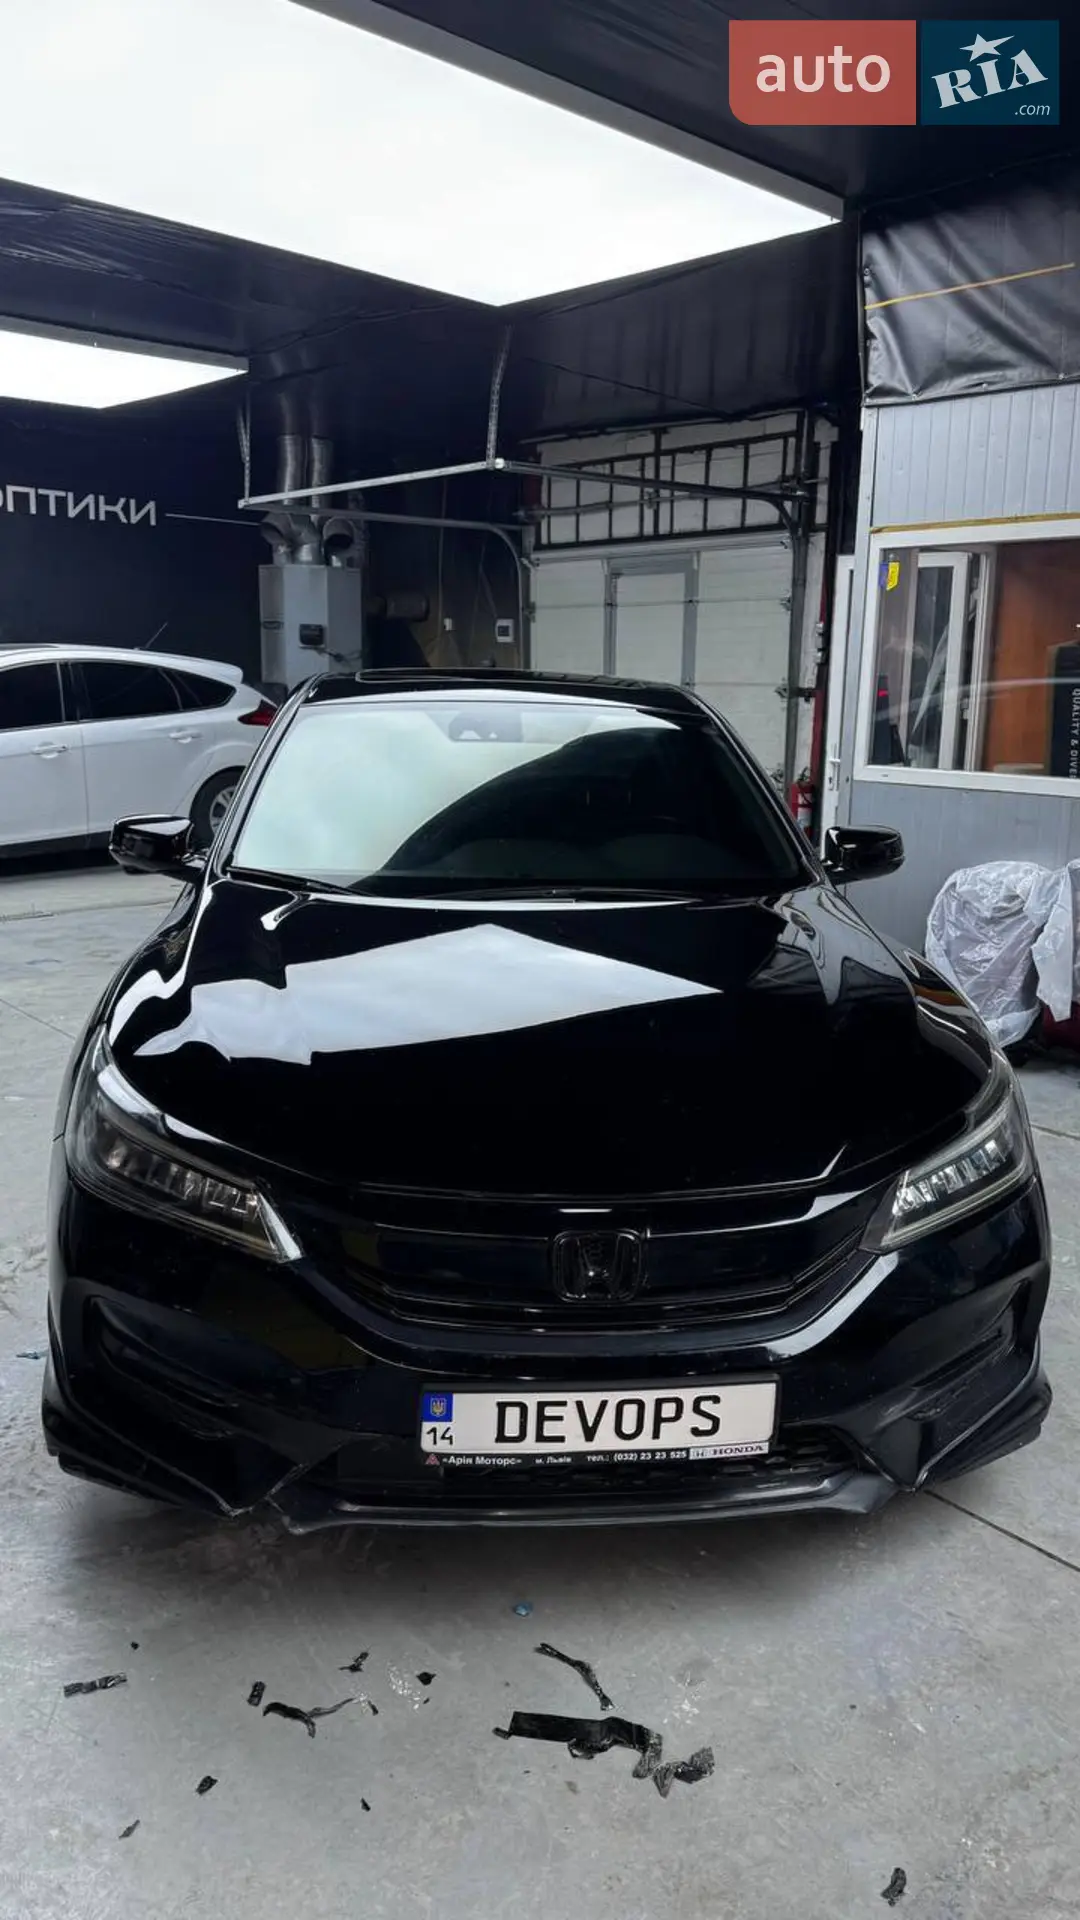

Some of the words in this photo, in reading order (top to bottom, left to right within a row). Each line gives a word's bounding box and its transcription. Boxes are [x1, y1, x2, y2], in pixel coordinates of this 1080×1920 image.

[0, 484, 156, 526] ПТИКИ
[1070, 688, 1080, 736] QUALITY
[494, 1394, 721, 1443] DEVOPS
[426, 1426, 453, 1446] 14
[713, 1445, 764, 1456] HONDA
[613, 1451, 638, 1461] (032)
